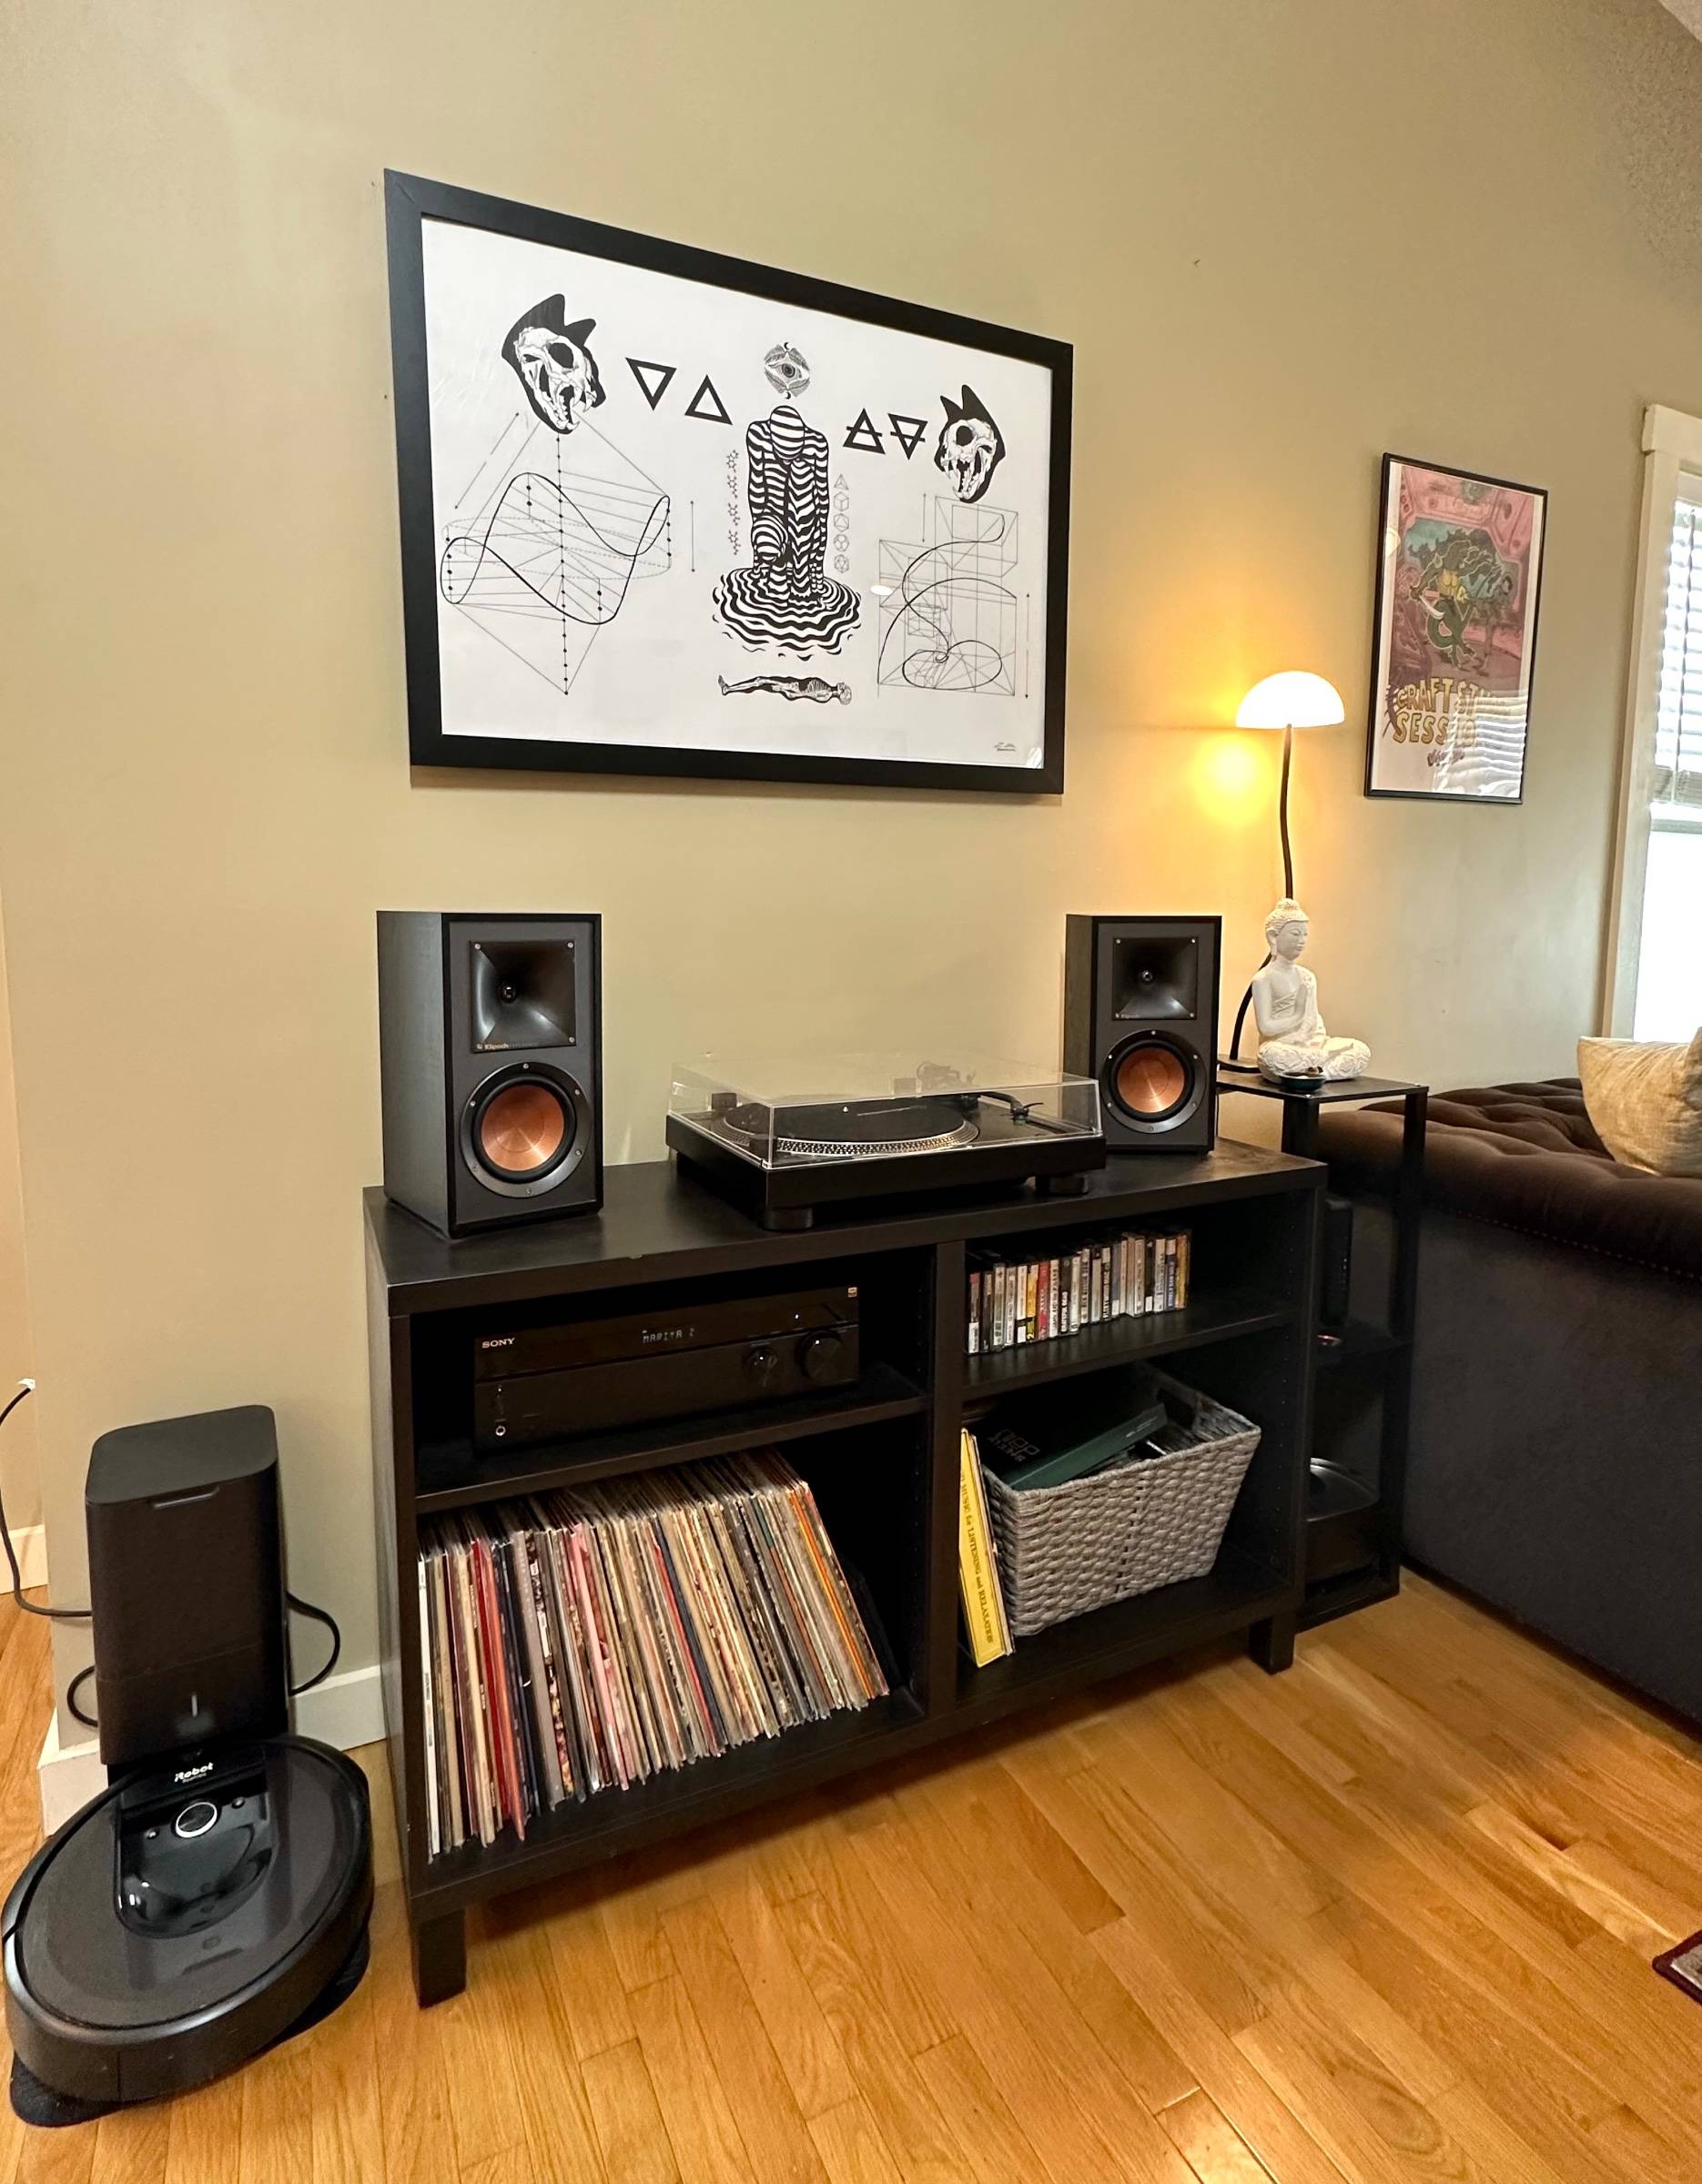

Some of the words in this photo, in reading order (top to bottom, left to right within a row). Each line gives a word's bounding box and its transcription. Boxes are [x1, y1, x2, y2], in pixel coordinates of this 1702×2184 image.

[1396, 677, 1454, 713] CRAFT
[481, 1337, 515, 1349] SONY
[968, 1527, 981, 1574] LISTENING
[175, 1762, 214, 1782] iRobot
